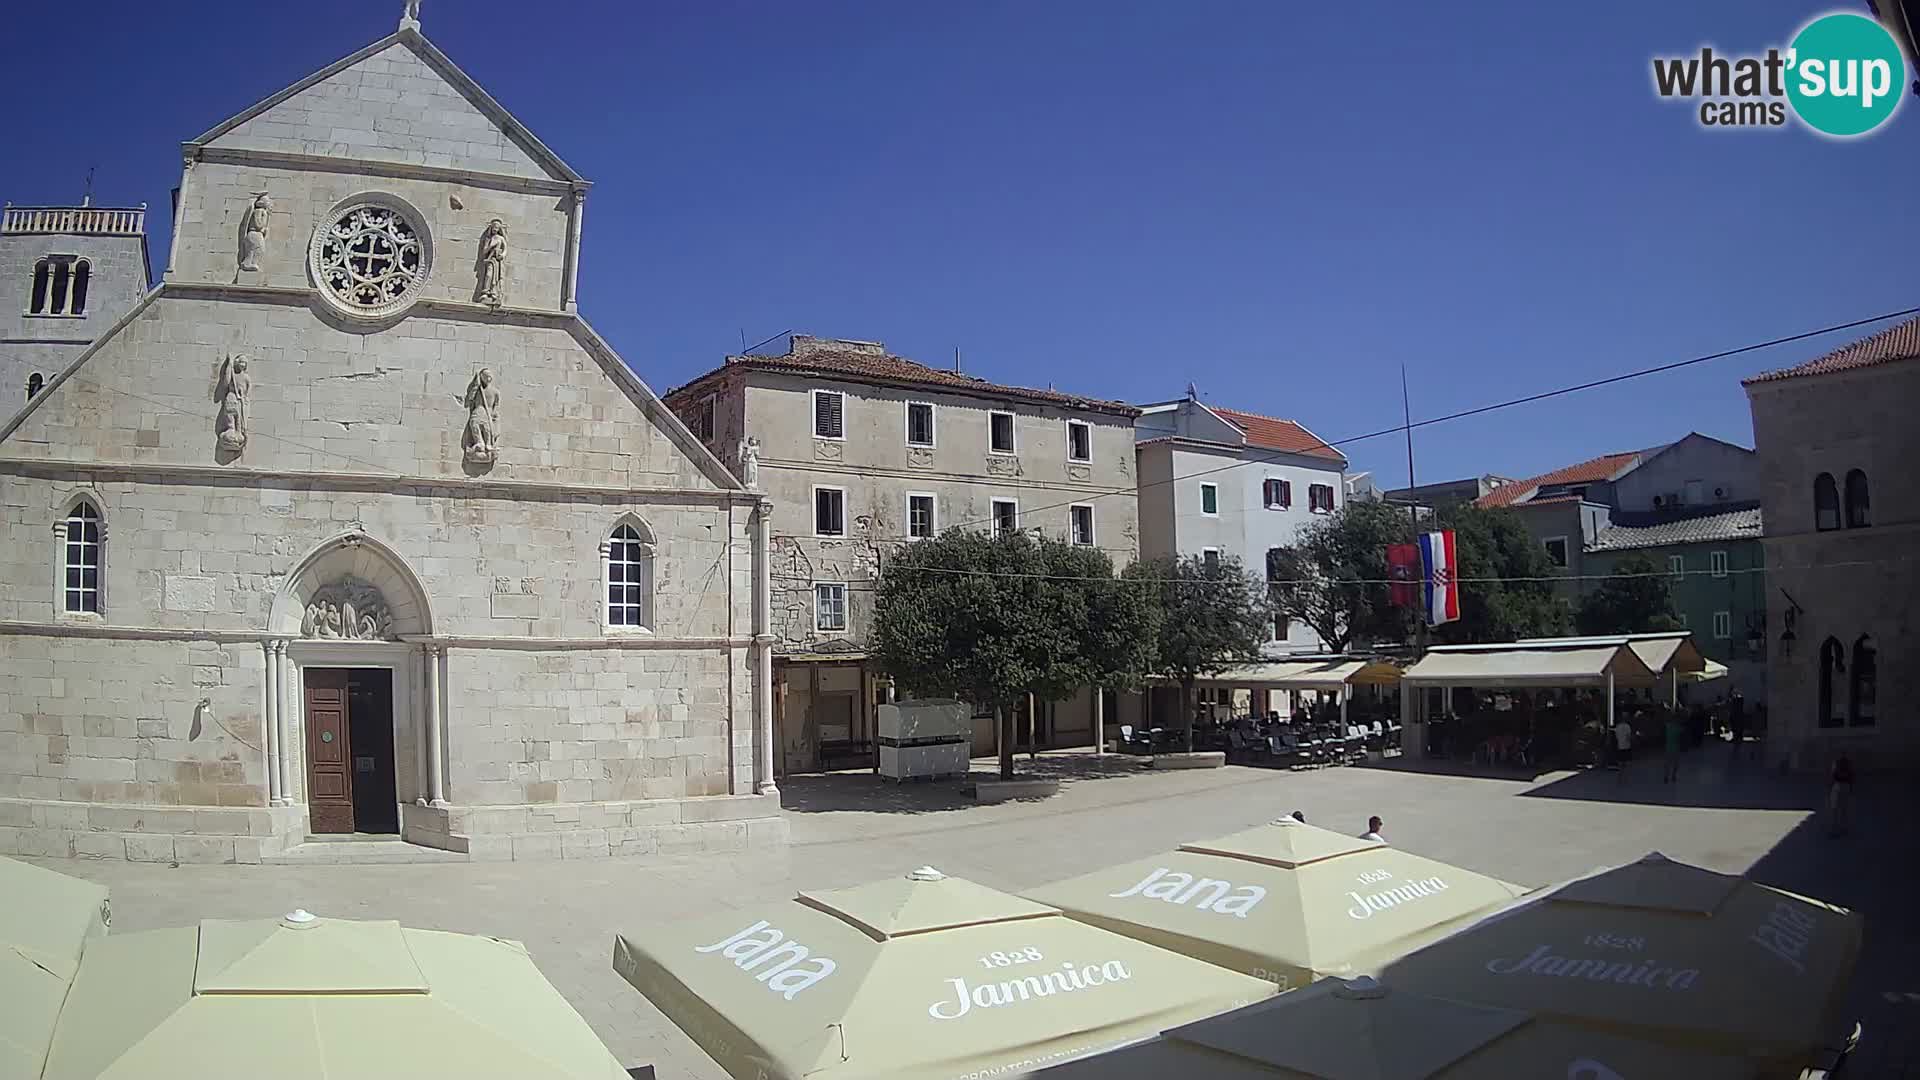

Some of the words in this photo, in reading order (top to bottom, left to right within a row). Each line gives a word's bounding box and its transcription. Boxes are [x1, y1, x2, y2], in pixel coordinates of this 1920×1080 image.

[1356, 869, 1393, 884] 1828
[1345, 876, 1449, 919] Jamnica
[979, 946, 1053, 969] 1828
[928, 960, 1132, 1019] Jamnica
